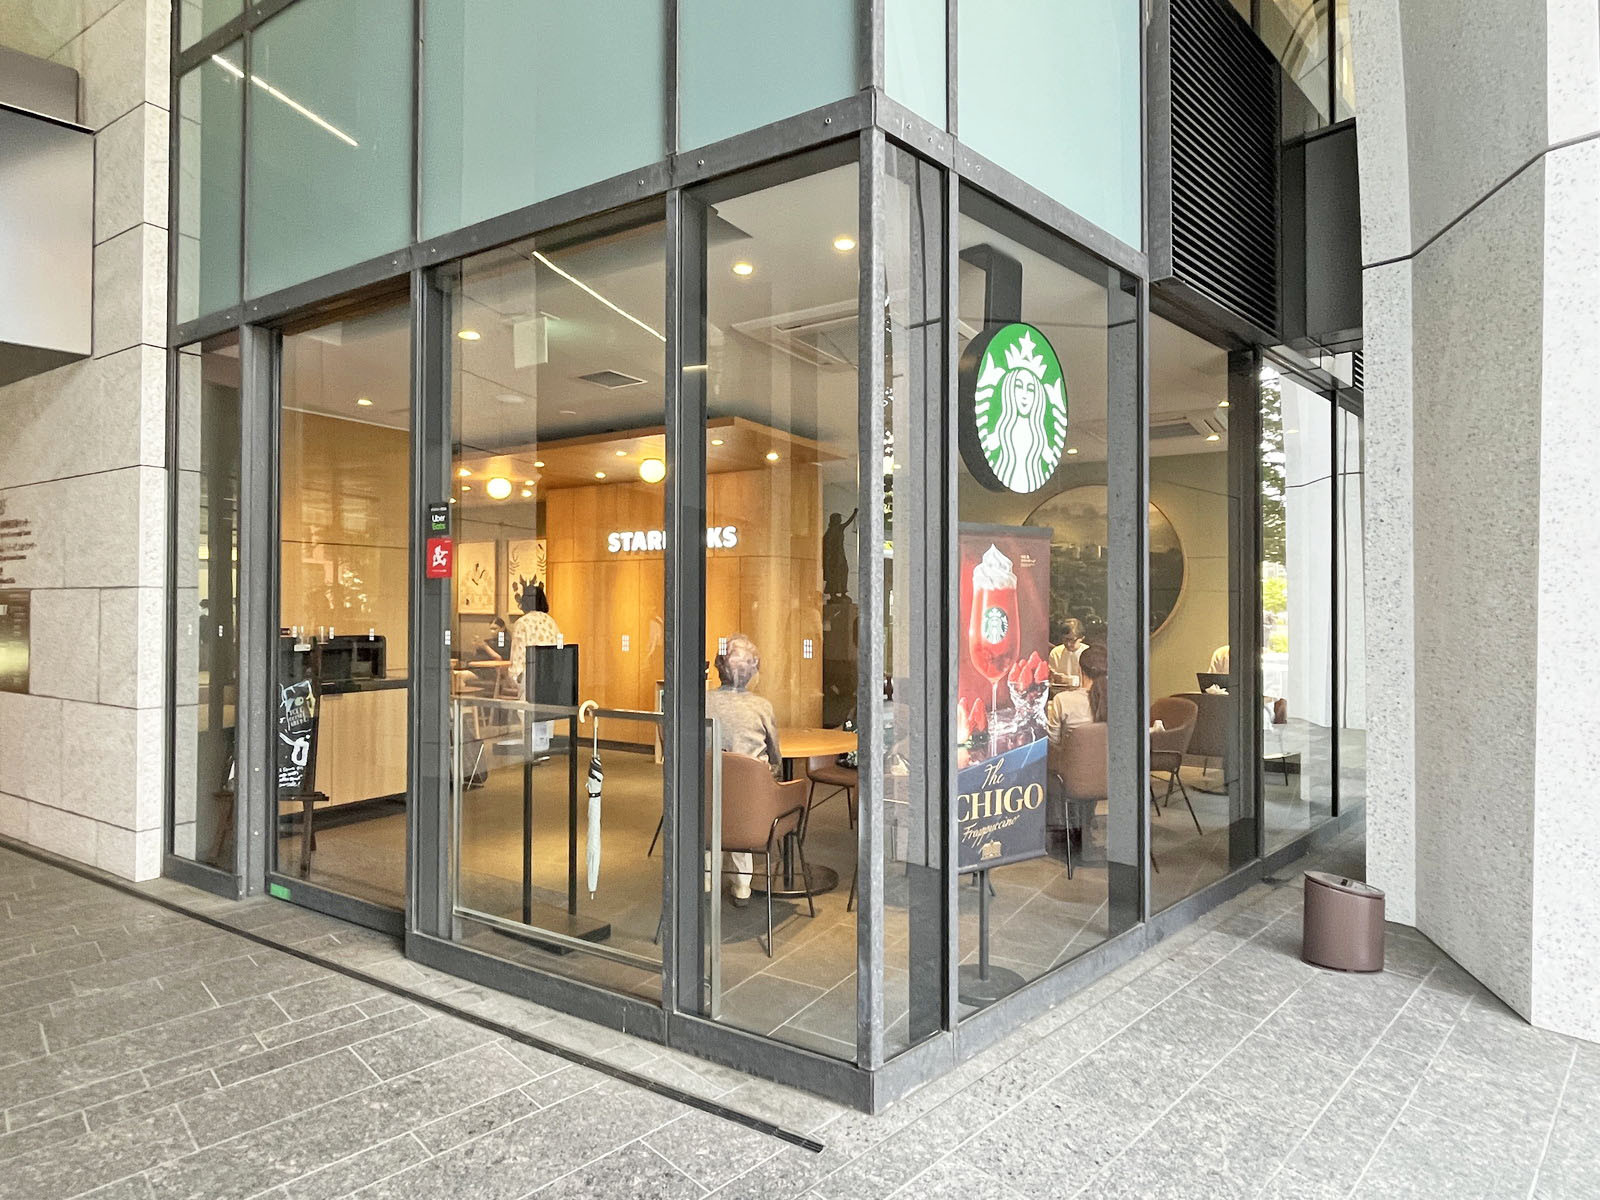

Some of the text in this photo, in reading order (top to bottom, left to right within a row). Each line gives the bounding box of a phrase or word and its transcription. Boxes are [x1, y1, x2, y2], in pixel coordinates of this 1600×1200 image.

[432, 514, 445, 522] Uber
[607, 525, 738, 553] STARKS
[981, 757, 1005, 790] The
[957, 782, 1044, 823] CHIGO
[961, 814, 1020, 848] Frappuccino
